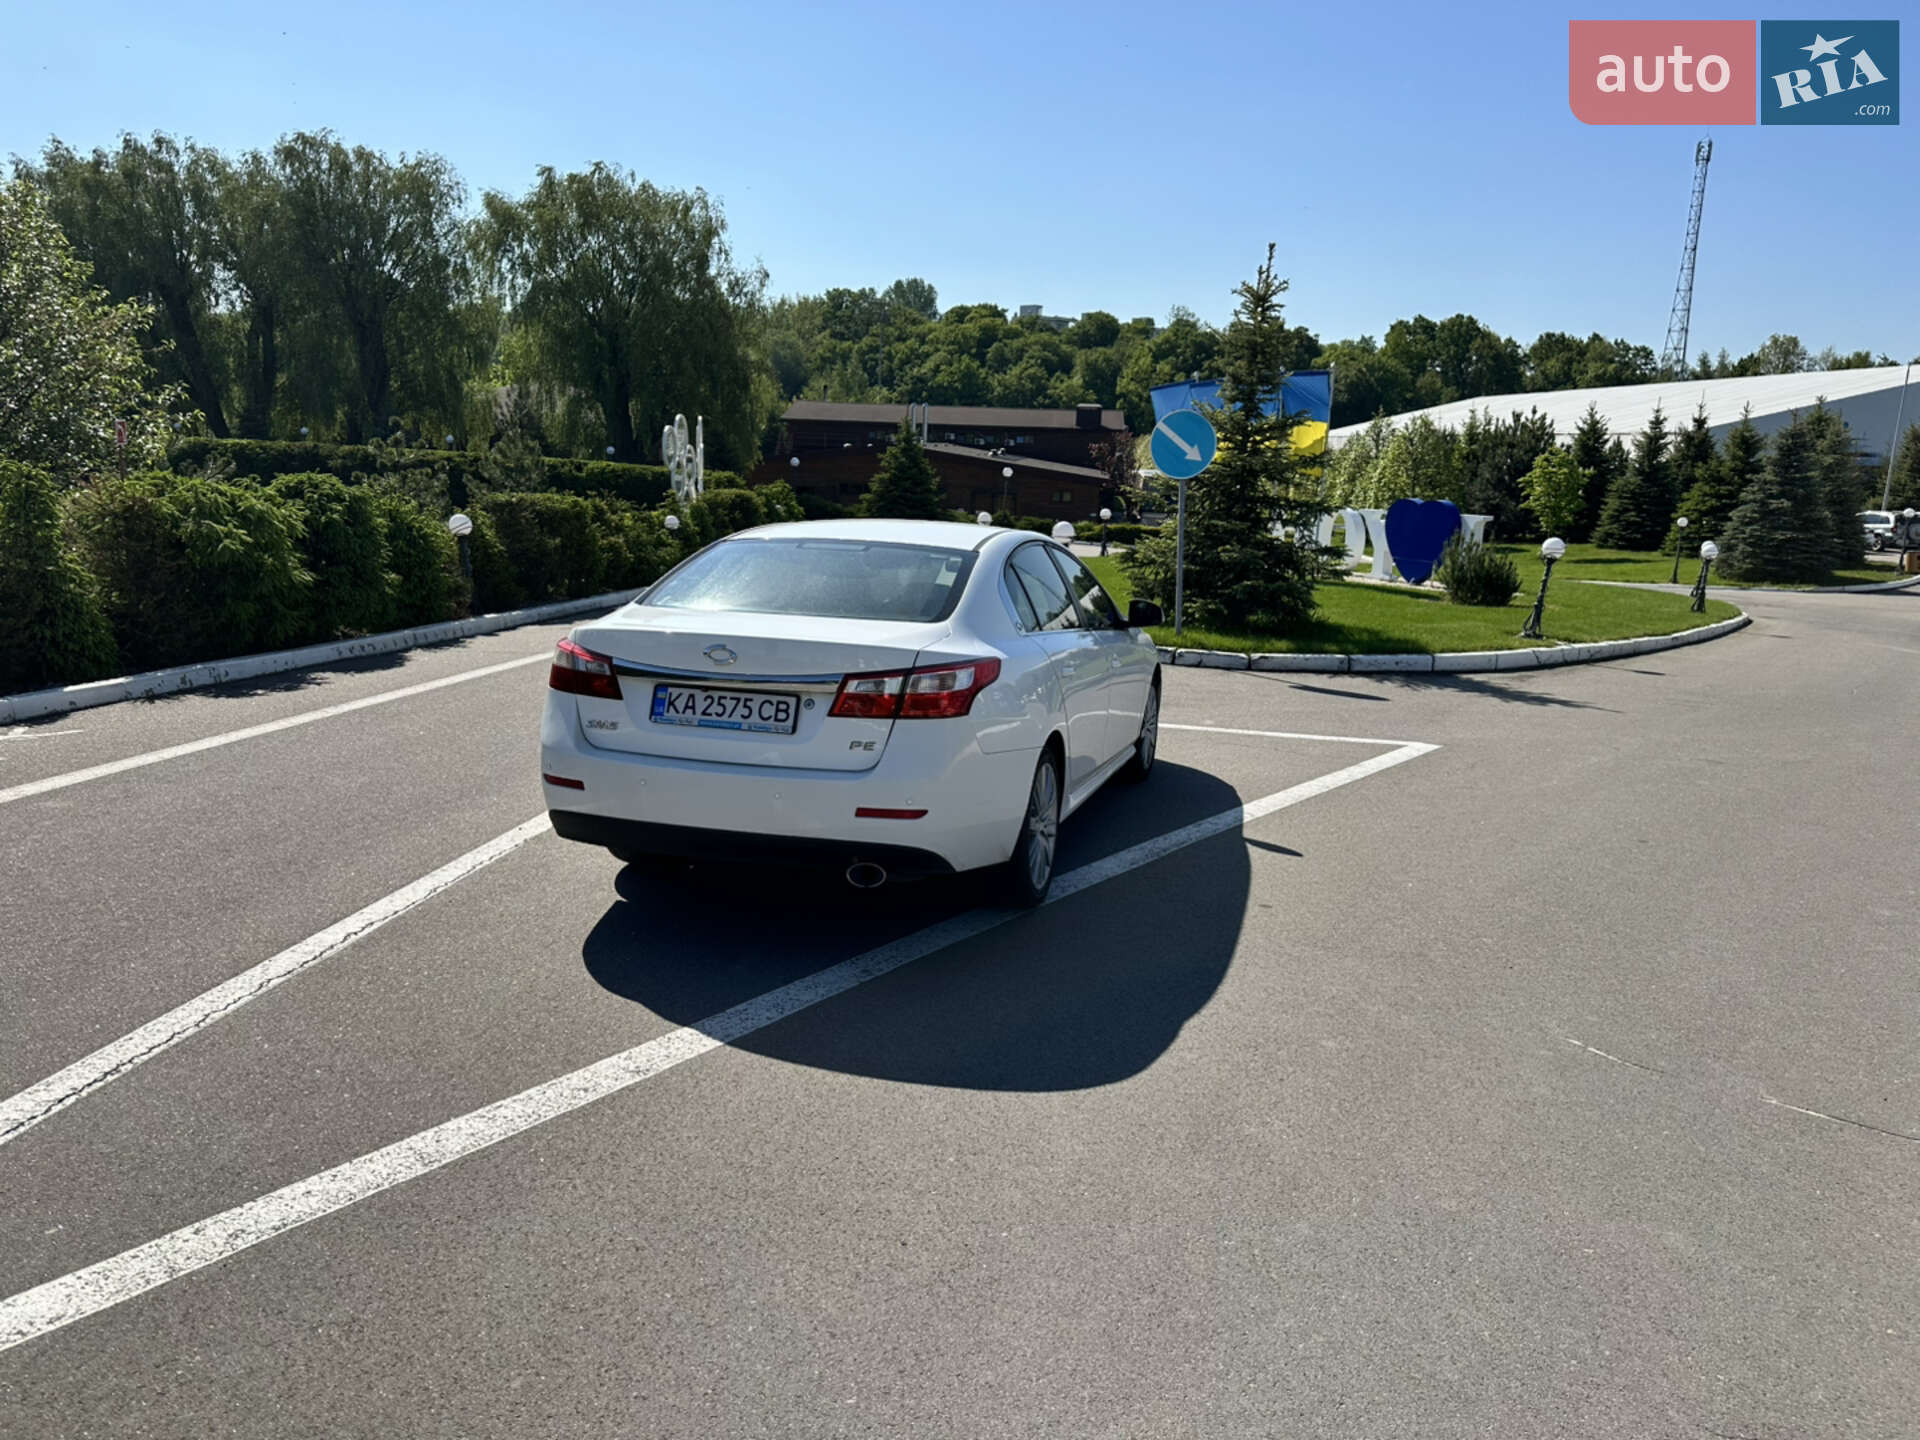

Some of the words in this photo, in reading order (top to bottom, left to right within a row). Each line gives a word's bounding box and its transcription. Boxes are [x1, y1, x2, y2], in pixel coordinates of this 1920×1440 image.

[666, 691, 696, 716] KA
[700, 694, 754, 720] 2575
[758, 699, 791, 724] CB
